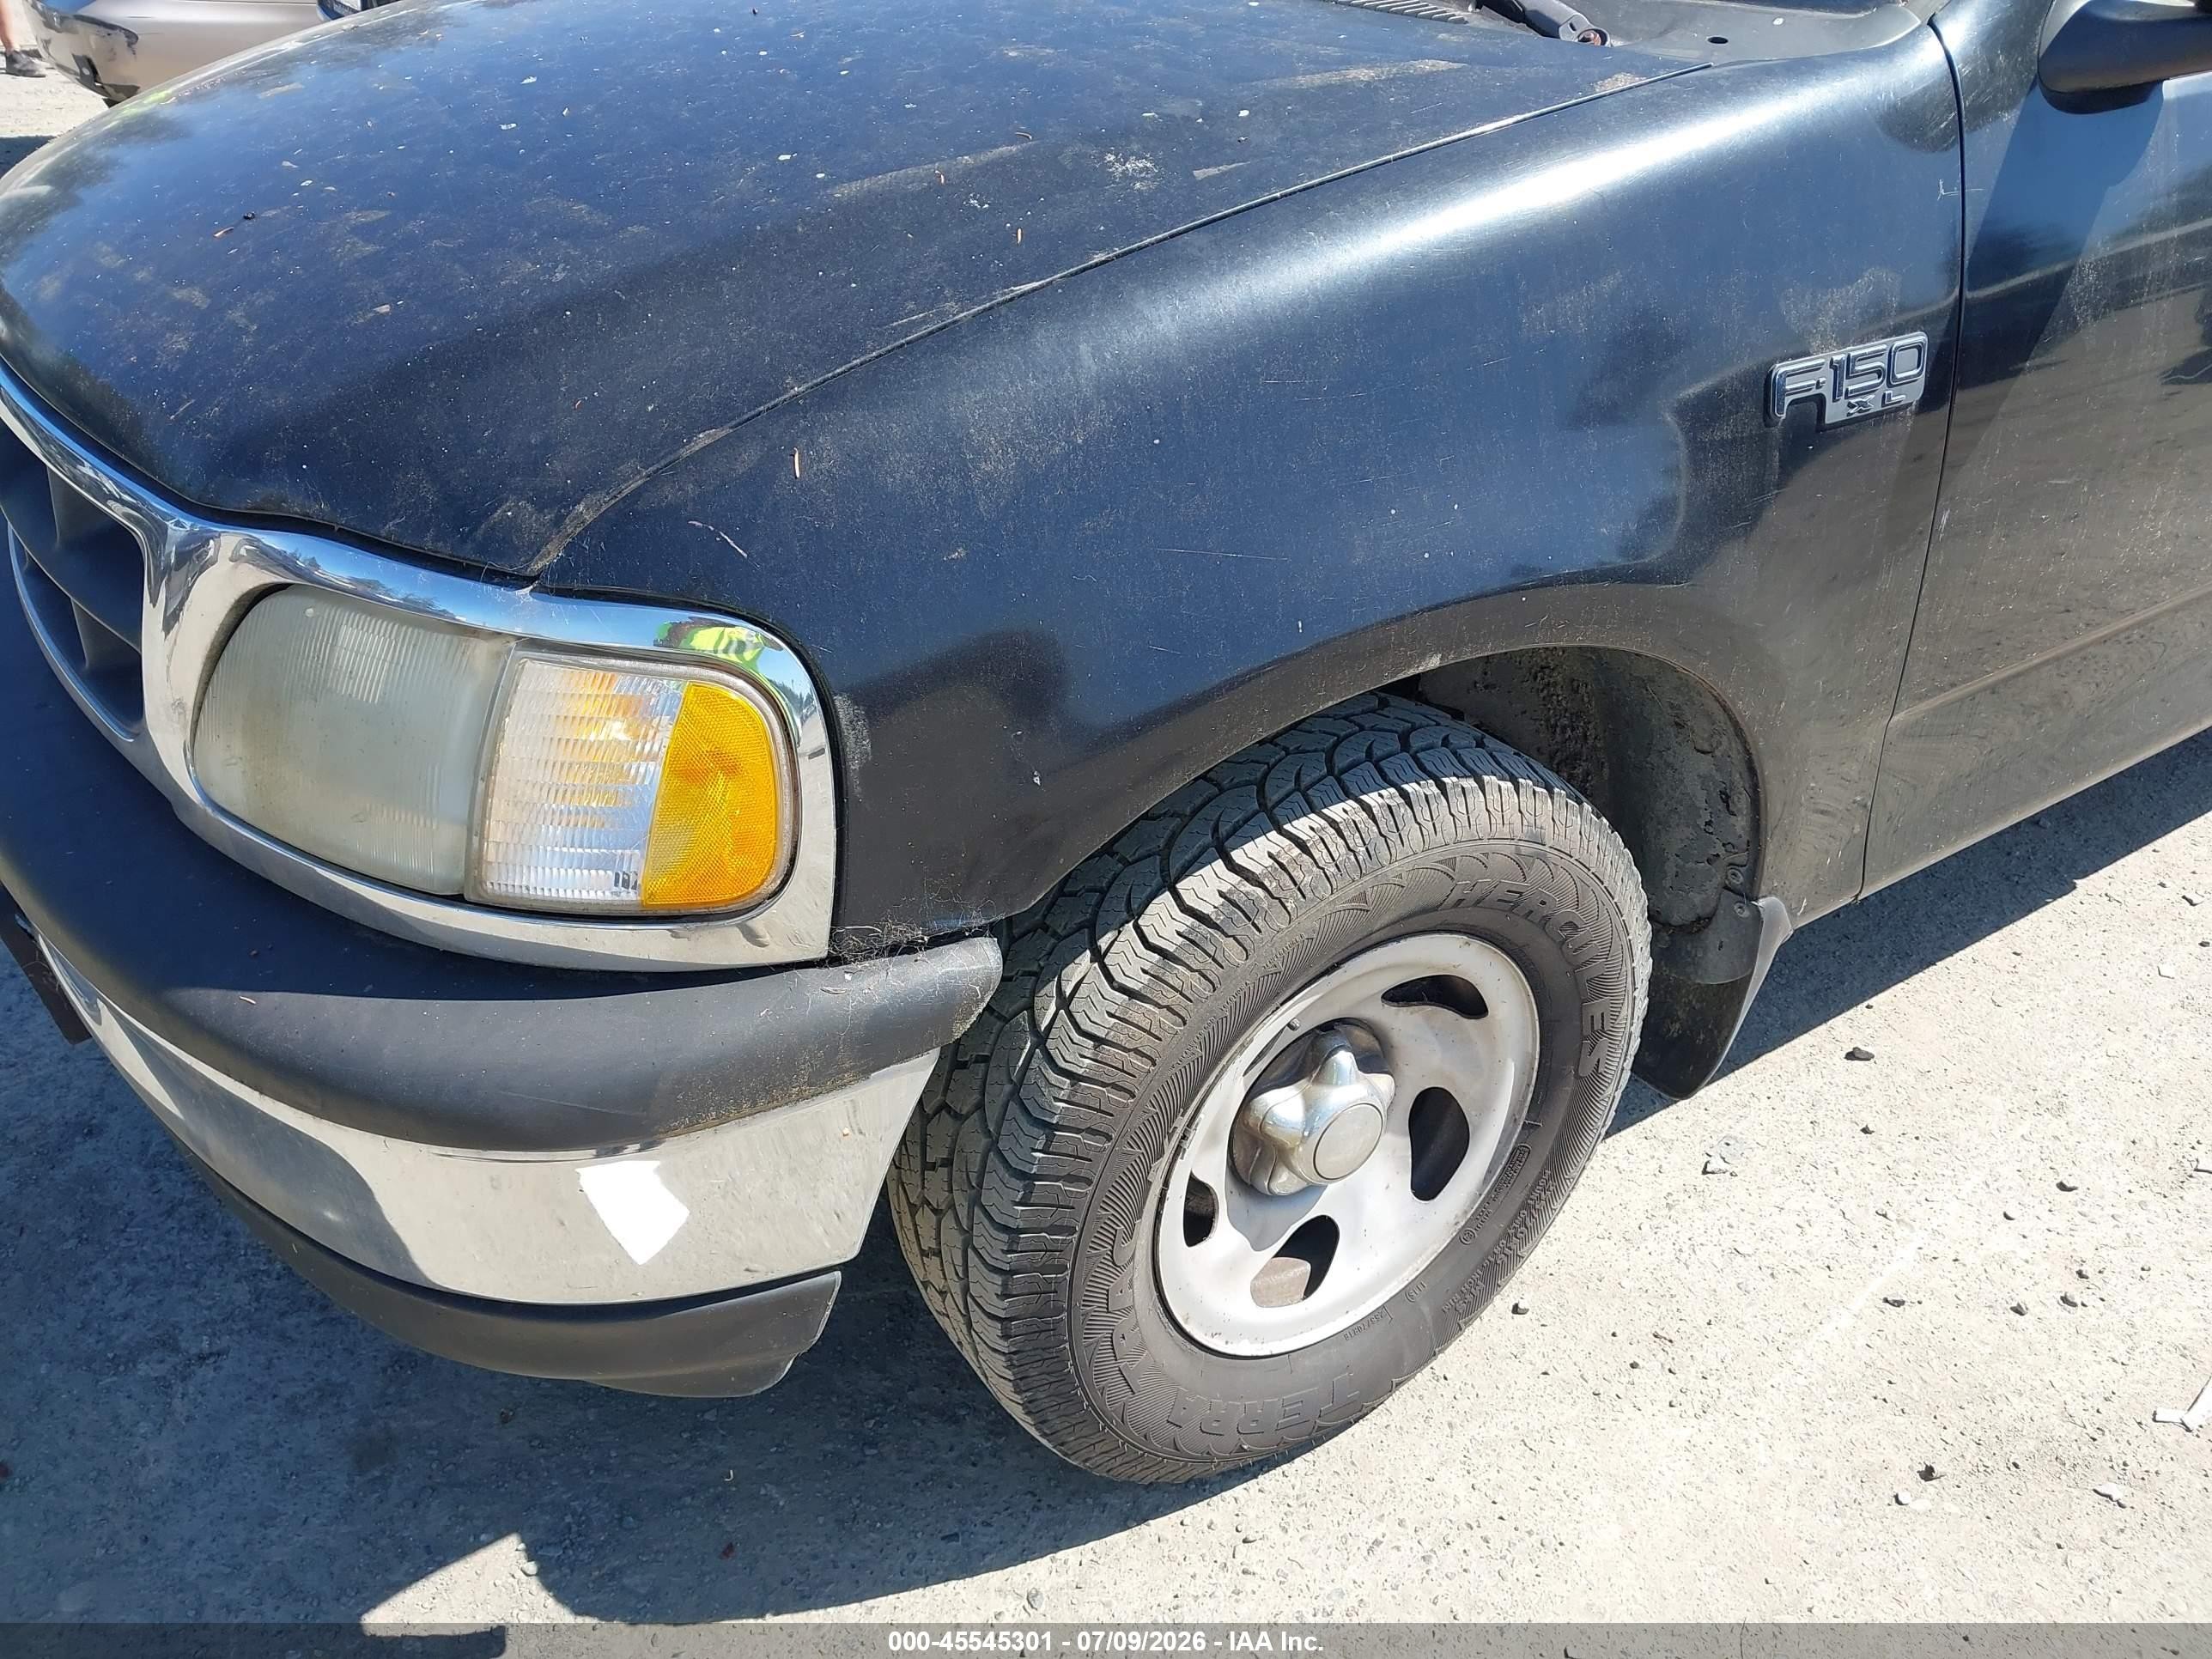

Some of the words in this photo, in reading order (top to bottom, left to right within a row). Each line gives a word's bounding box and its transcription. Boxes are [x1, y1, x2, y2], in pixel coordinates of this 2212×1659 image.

[1846, 391, 1905, 415] XL
[1438, 879, 1610, 1077] HERCULES
[1107, 1218, 1149, 1395] TRAC
[1168, 1372, 1363, 1436] TERRA
